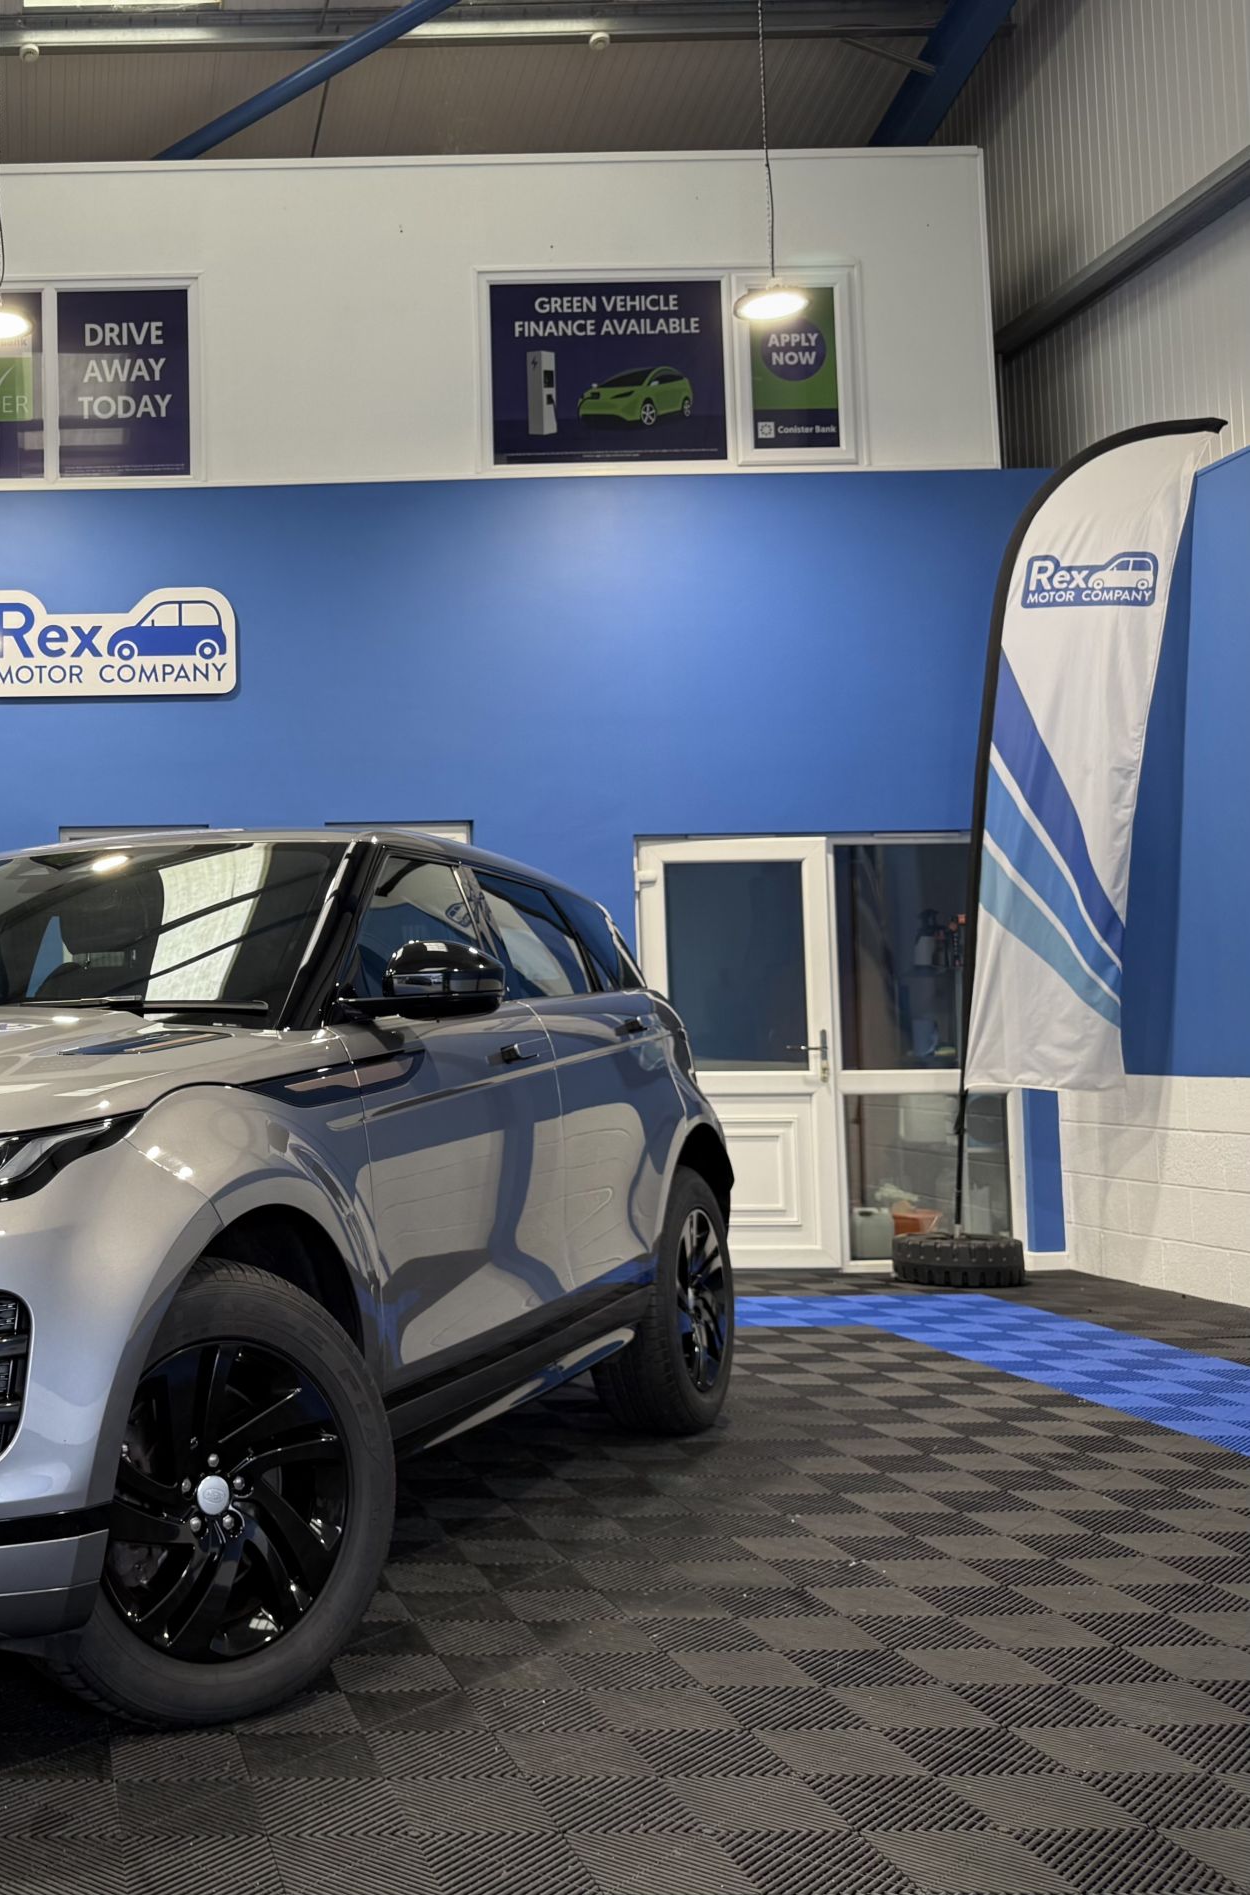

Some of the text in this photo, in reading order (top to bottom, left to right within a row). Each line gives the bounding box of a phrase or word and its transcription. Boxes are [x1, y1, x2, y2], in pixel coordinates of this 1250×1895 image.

[534, 294, 678, 313] GREEN VEHICLE
[84, 321, 164, 347] DRIVE
[514, 317, 700, 337] FINANCE AVAILABLE
[767, 333, 819, 347] APPLY
[771, 351, 816, 365] NOW
[83, 357, 166, 383] AWAY
[78, 394, 172, 420] TODAY
[777, 424, 837, 434] Conister Bank
[1029, 560, 1089, 591] Rex
[1027, 590, 1152, 604] MOTOR COMPANY
[99, 662, 228, 683] COMPANY
